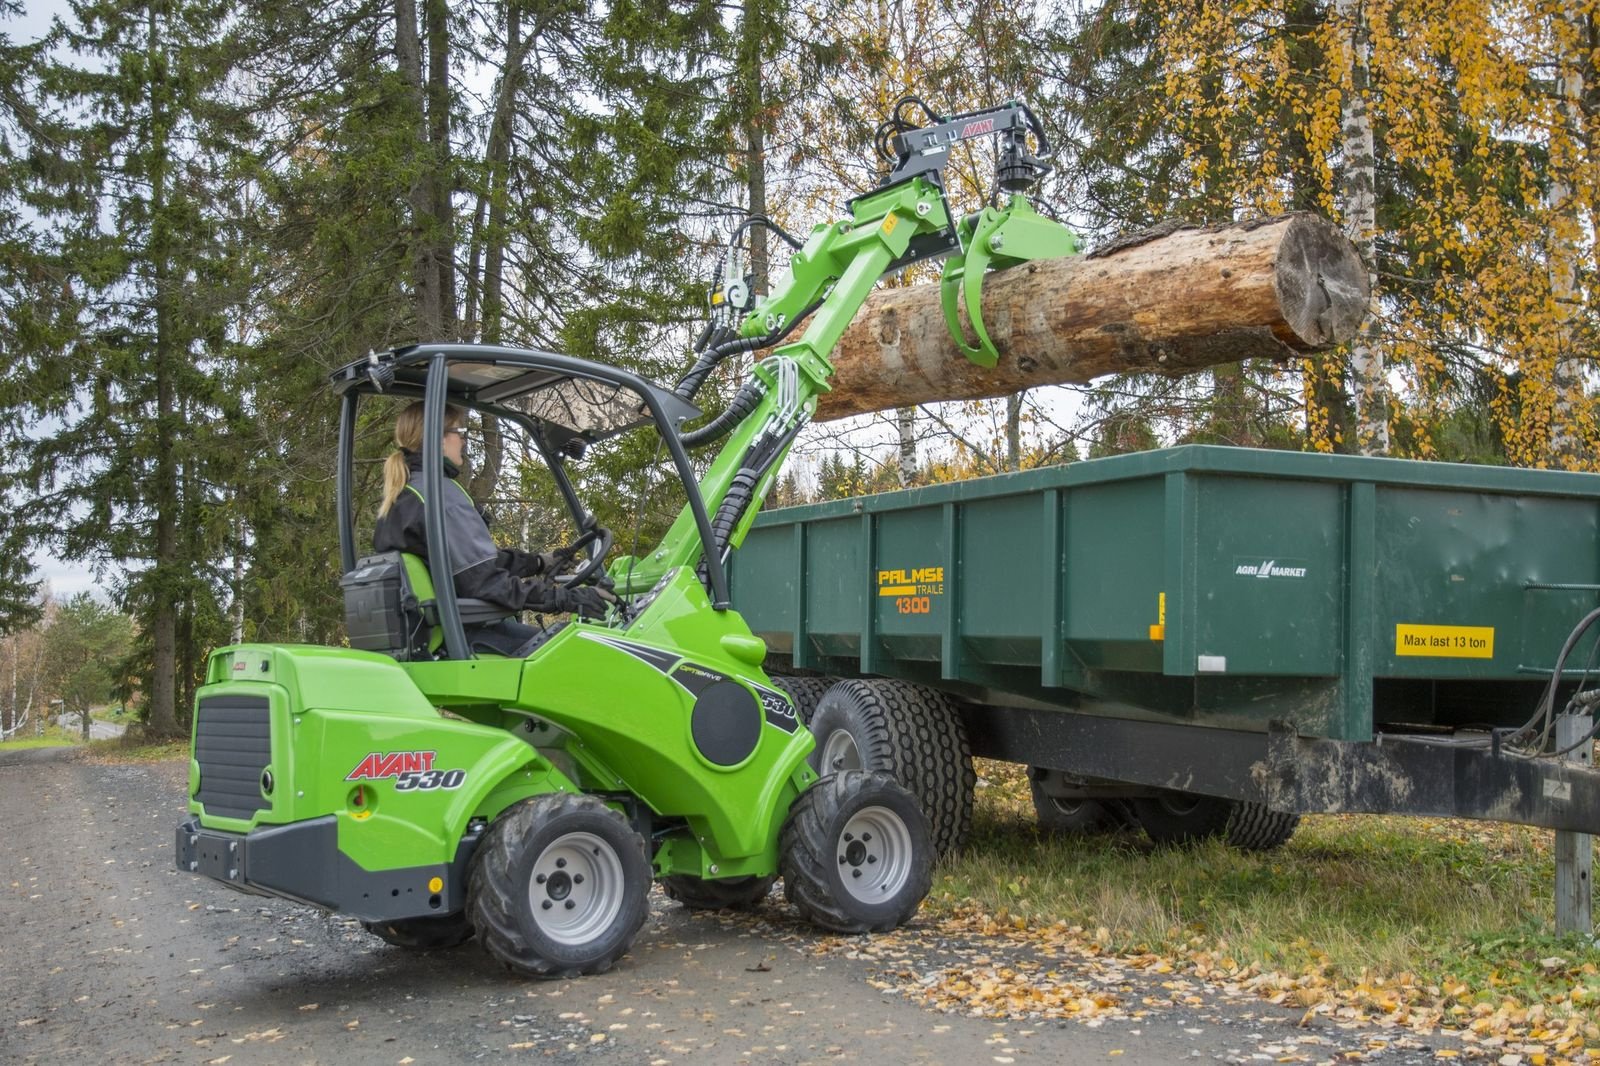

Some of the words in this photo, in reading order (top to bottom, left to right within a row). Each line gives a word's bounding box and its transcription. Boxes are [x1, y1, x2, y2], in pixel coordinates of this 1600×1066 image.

[961, 118, 994, 139] AVANT
[879, 567, 944, 585] PALMSE
[1235, 565, 1258, 575] AGRI
[1270, 567, 1306, 577] MARKET
[917, 584, 944, 595] TRAILE
[896, 596, 930, 614] 1300
[1404, 634, 1427, 646] Max
[1429, 635, 1450, 647] last
[1454, 636, 1466, 648] 13
[1469, 637, 1486, 648] ton
[761, 693, 797, 719] 530
[344, 751, 437, 782] AVANT
[395, 769, 468, 792] 530
